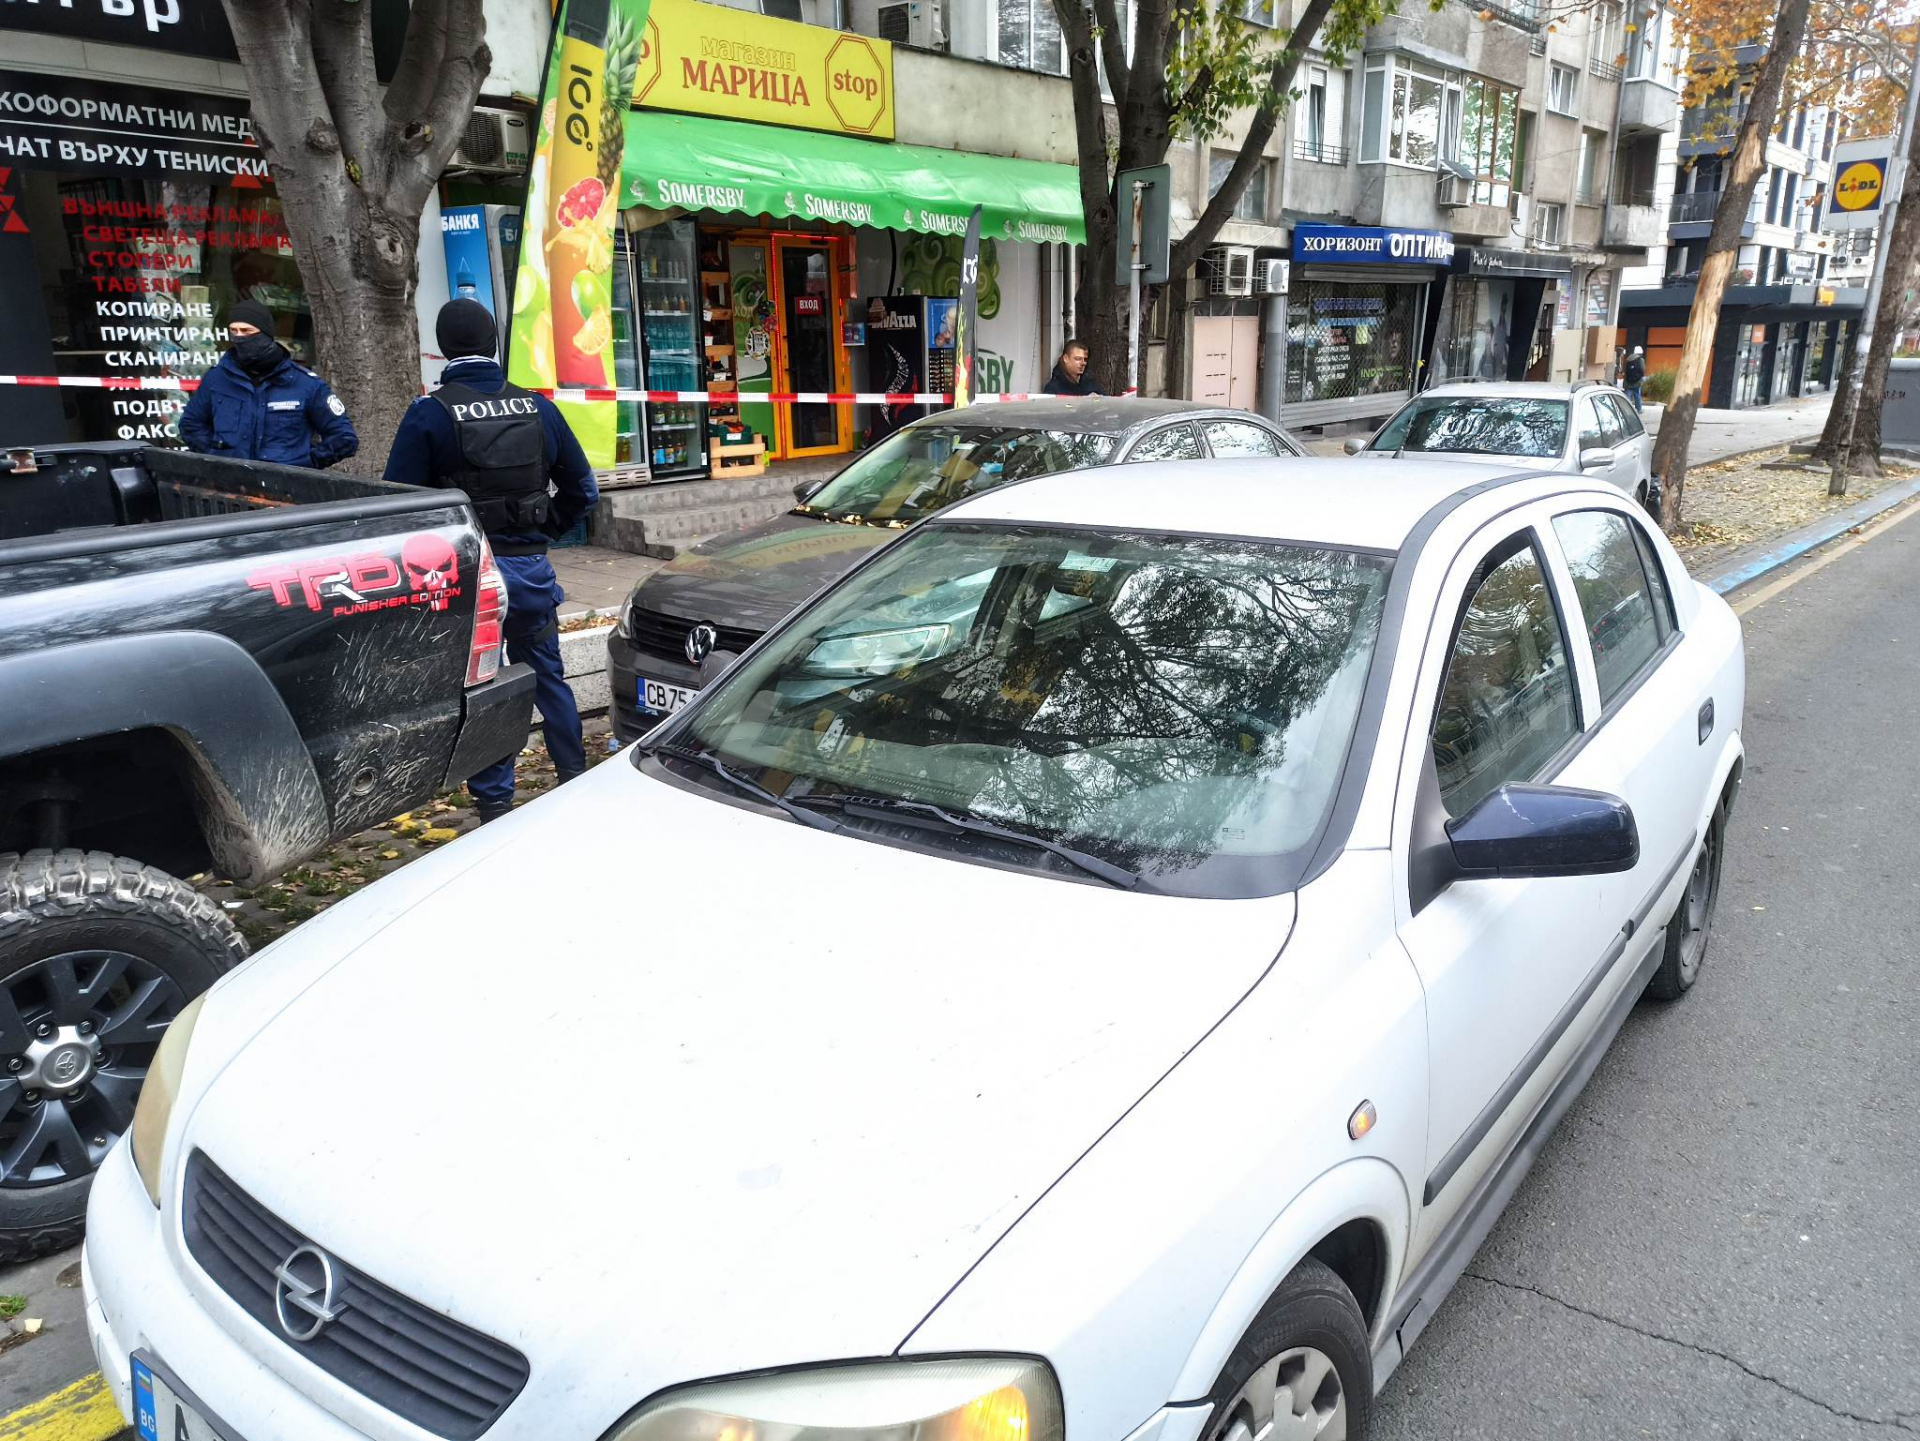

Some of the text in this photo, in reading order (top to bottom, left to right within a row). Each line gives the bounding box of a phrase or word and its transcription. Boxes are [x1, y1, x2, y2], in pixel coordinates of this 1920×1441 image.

[700, 36, 796, 72] магазин
[680, 56, 811, 107] МАРИЦА
[833, 69, 878, 101] stop
[0, 91, 196, 131] КОФОРМАТНИ
[58, 140, 148, 167] ВЪРХУ
[153, 149, 269, 177] ТЕНИСКИ
[62, 195, 168, 219] ВЪНШНА
[440, 213, 480, 232] БАНКЯ
[920, 209, 970, 233] SOMERS
[1018, 219, 1068, 241] SOMERSBY
[83, 224, 293, 249] СВЕТЕЩА РЕКЛАМА
[1303, 236, 1383, 252] ХОРИЗОНТ
[88, 251, 194, 270] СТОПЕРИ
[91, 275, 181, 293] ТАБЕЛИ
[96, 301, 213, 318] КОПИРАНЕ
[799, 299, 819, 310] ВХОД
[100, 326, 230, 341] ПРИНТИРАН
[452, 397, 538, 421] POLICE
[117, 423, 178, 440] ФАКС
[245, 554, 401, 612] TRD
[333, 587, 462, 617] PUNISHER EDITION
[140, 1409, 155, 1432] BG
